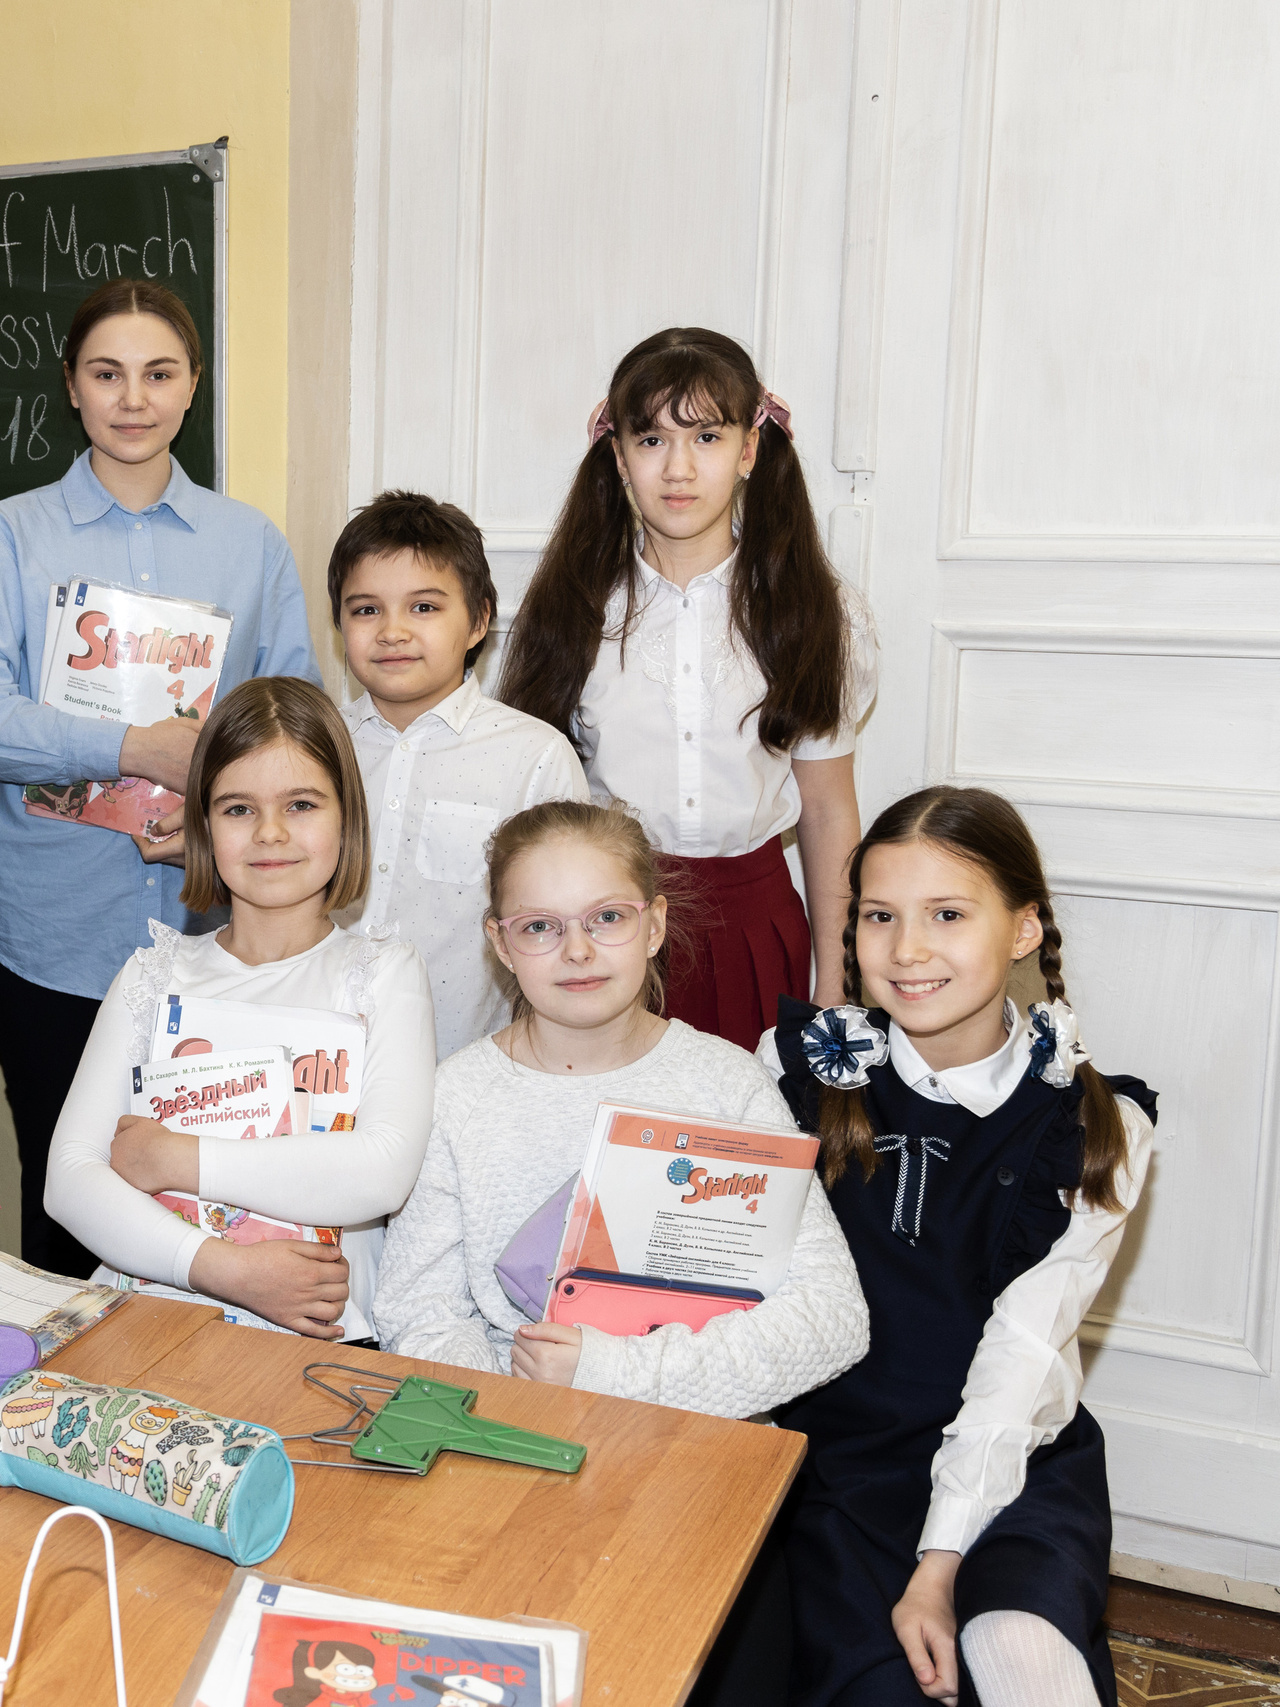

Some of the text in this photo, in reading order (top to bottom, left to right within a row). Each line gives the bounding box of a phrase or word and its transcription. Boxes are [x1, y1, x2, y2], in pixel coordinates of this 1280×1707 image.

[42, 186, 198, 293] March
[67, 610, 215, 674] Starlight
[166, 679, 185, 700] 4
[63, 693, 122, 716] Student's Book
[191, 1066, 198, 1074] Л.
[198, 1063, 225, 1073] Бахтина
[228, 1057, 275, 1069] К. К. Романова
[156, 1069, 178, 1081] Сахаров
[150, 1069, 268, 1122] Звёздный
[180, 1103, 271, 1127] английский
[681, 1167, 768, 1205] Starlight
[745, 1199, 758, 1214] 4
[397, 1650, 527, 1688] DIPPER
